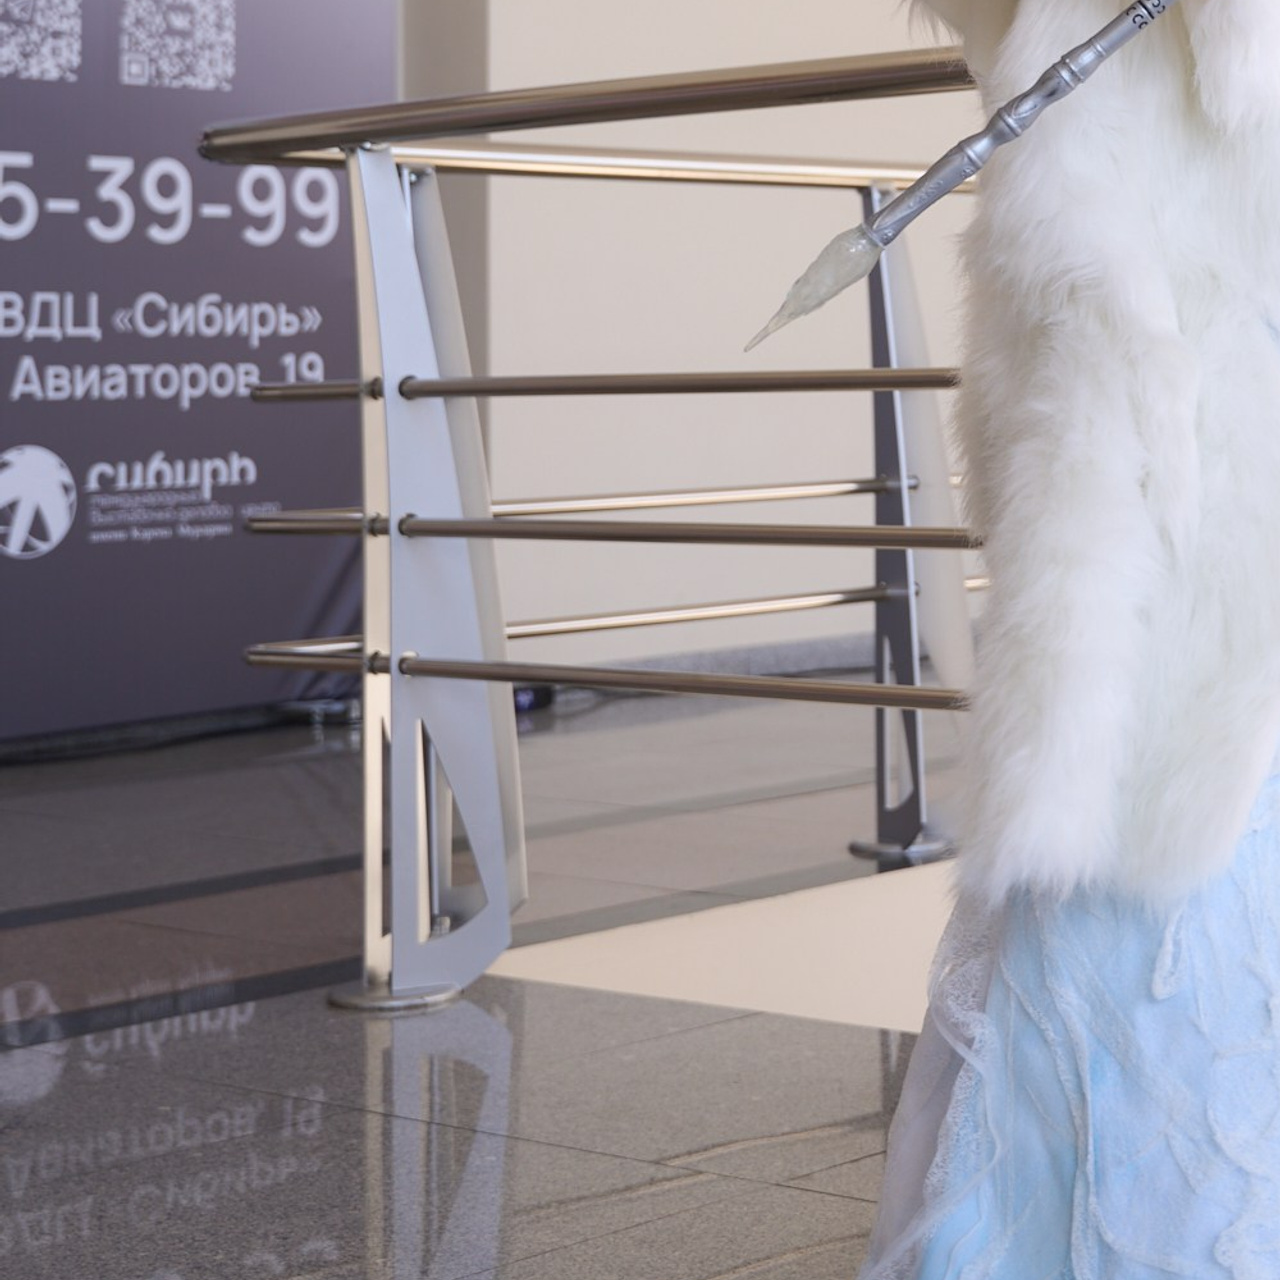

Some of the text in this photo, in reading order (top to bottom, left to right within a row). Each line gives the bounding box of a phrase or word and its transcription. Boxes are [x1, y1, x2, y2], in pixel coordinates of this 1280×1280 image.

[0, 151, 340, 247] 5-39-99
[112, 291, 323, 349] «Сибирь»
[10, 355, 260, 411] Авиаторов
